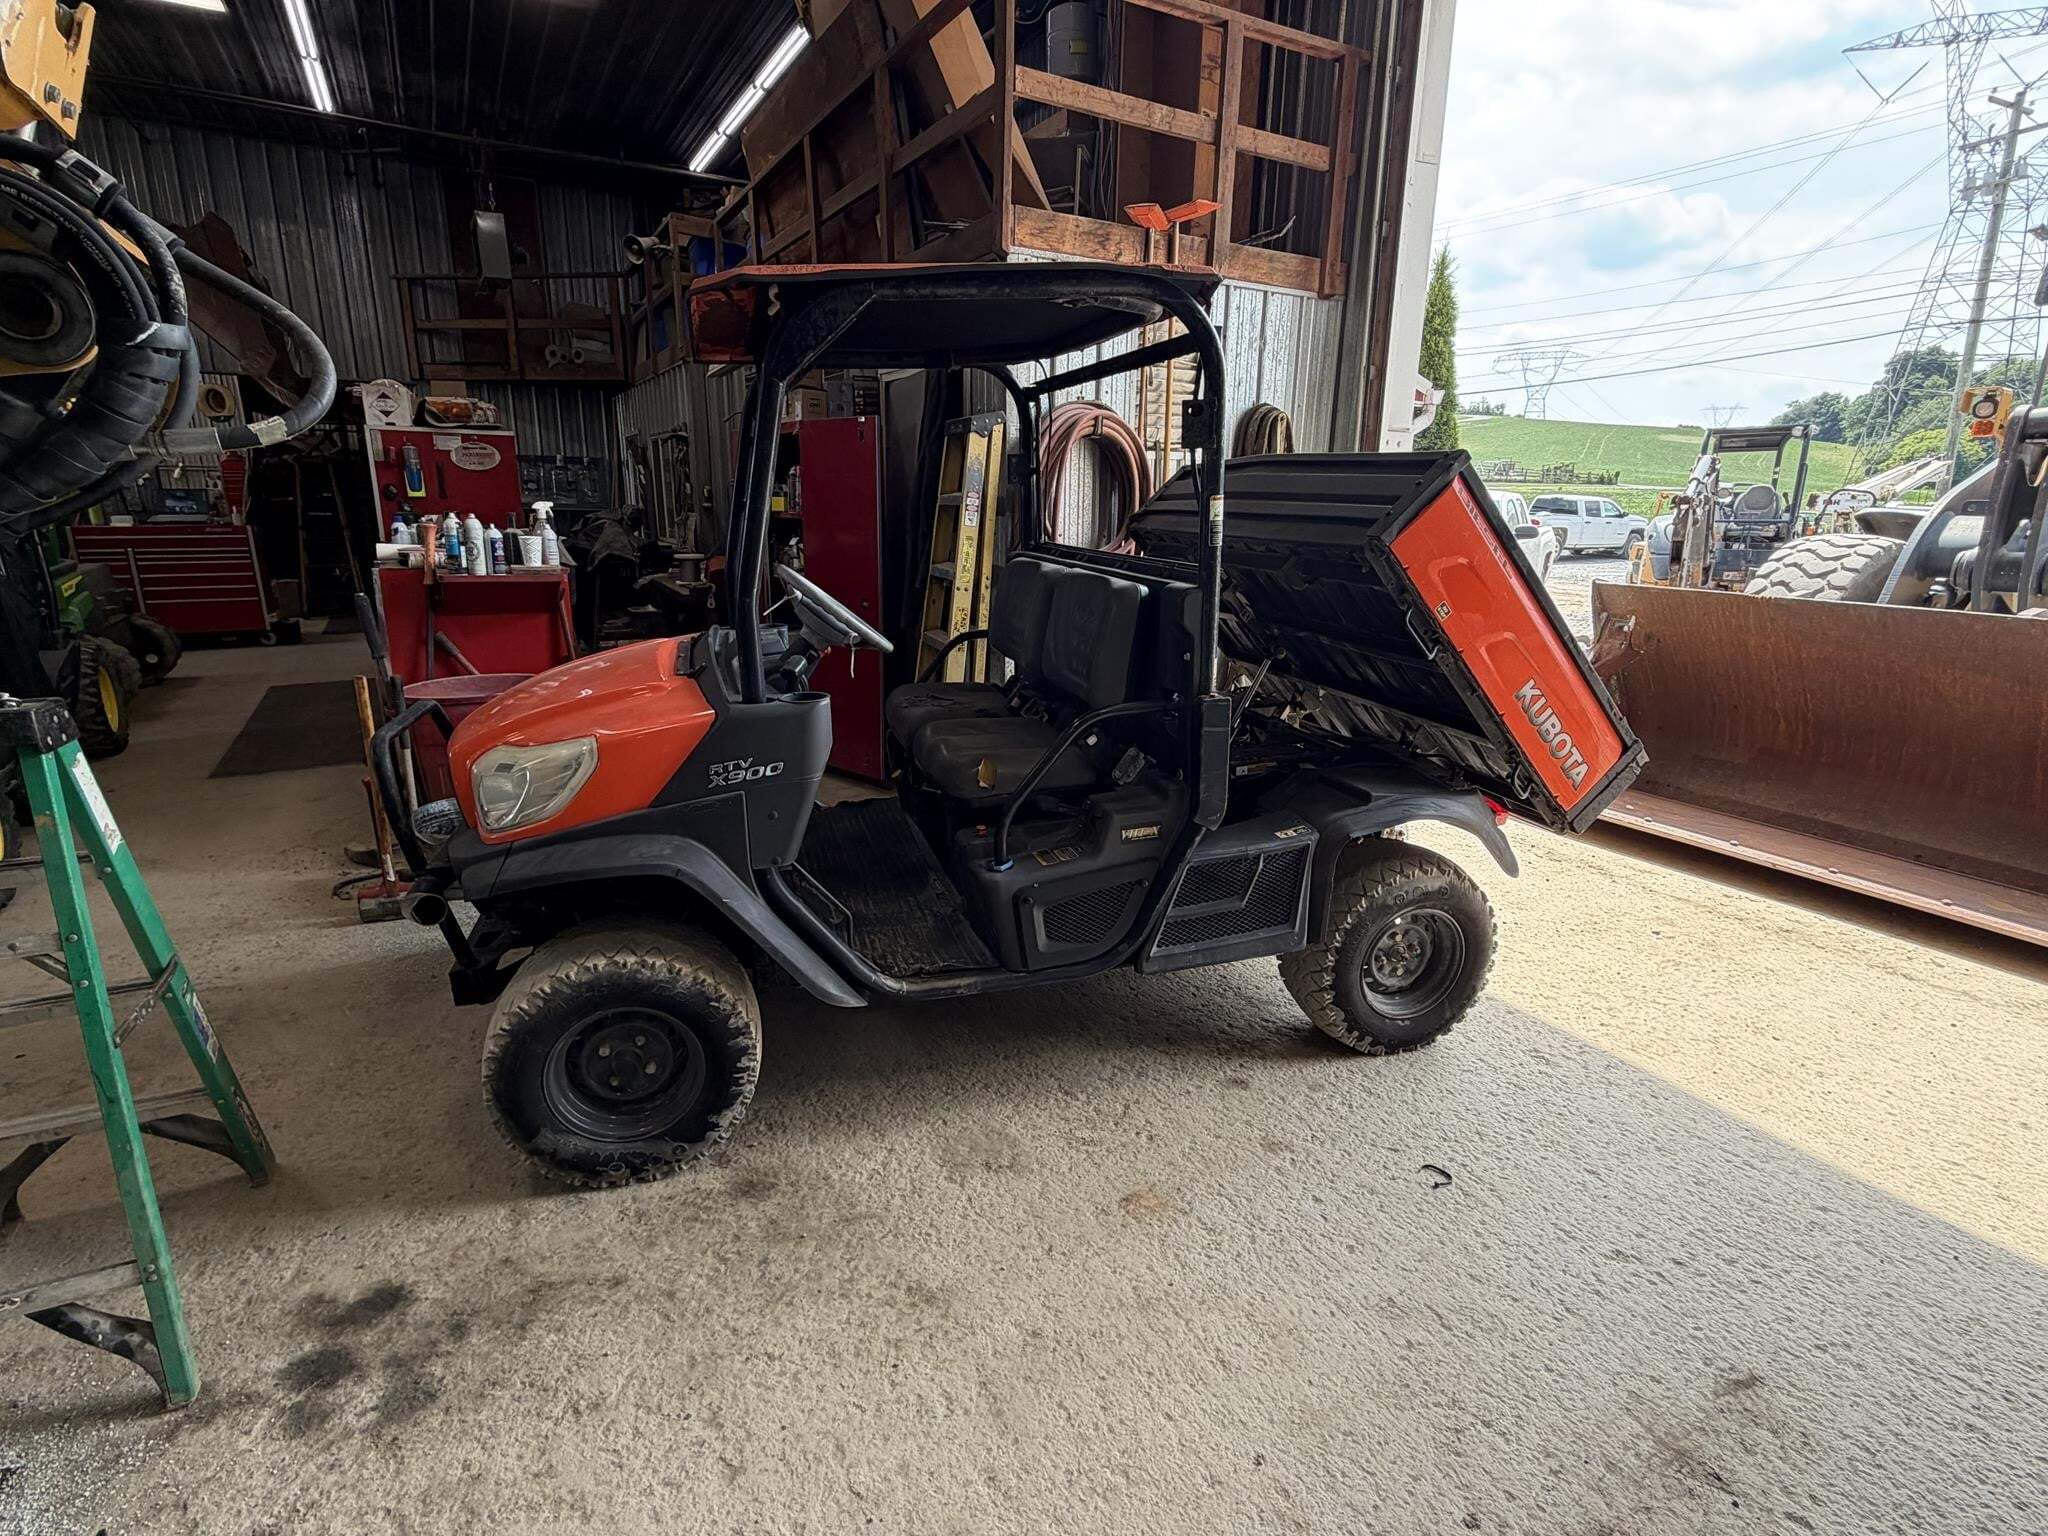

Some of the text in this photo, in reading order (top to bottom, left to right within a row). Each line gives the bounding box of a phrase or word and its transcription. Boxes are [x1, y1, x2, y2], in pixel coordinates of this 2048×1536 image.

[1513, 678, 1590, 791] KUBOTA
[707, 762, 784, 788] X900
[708, 757, 754, 775] RTV
